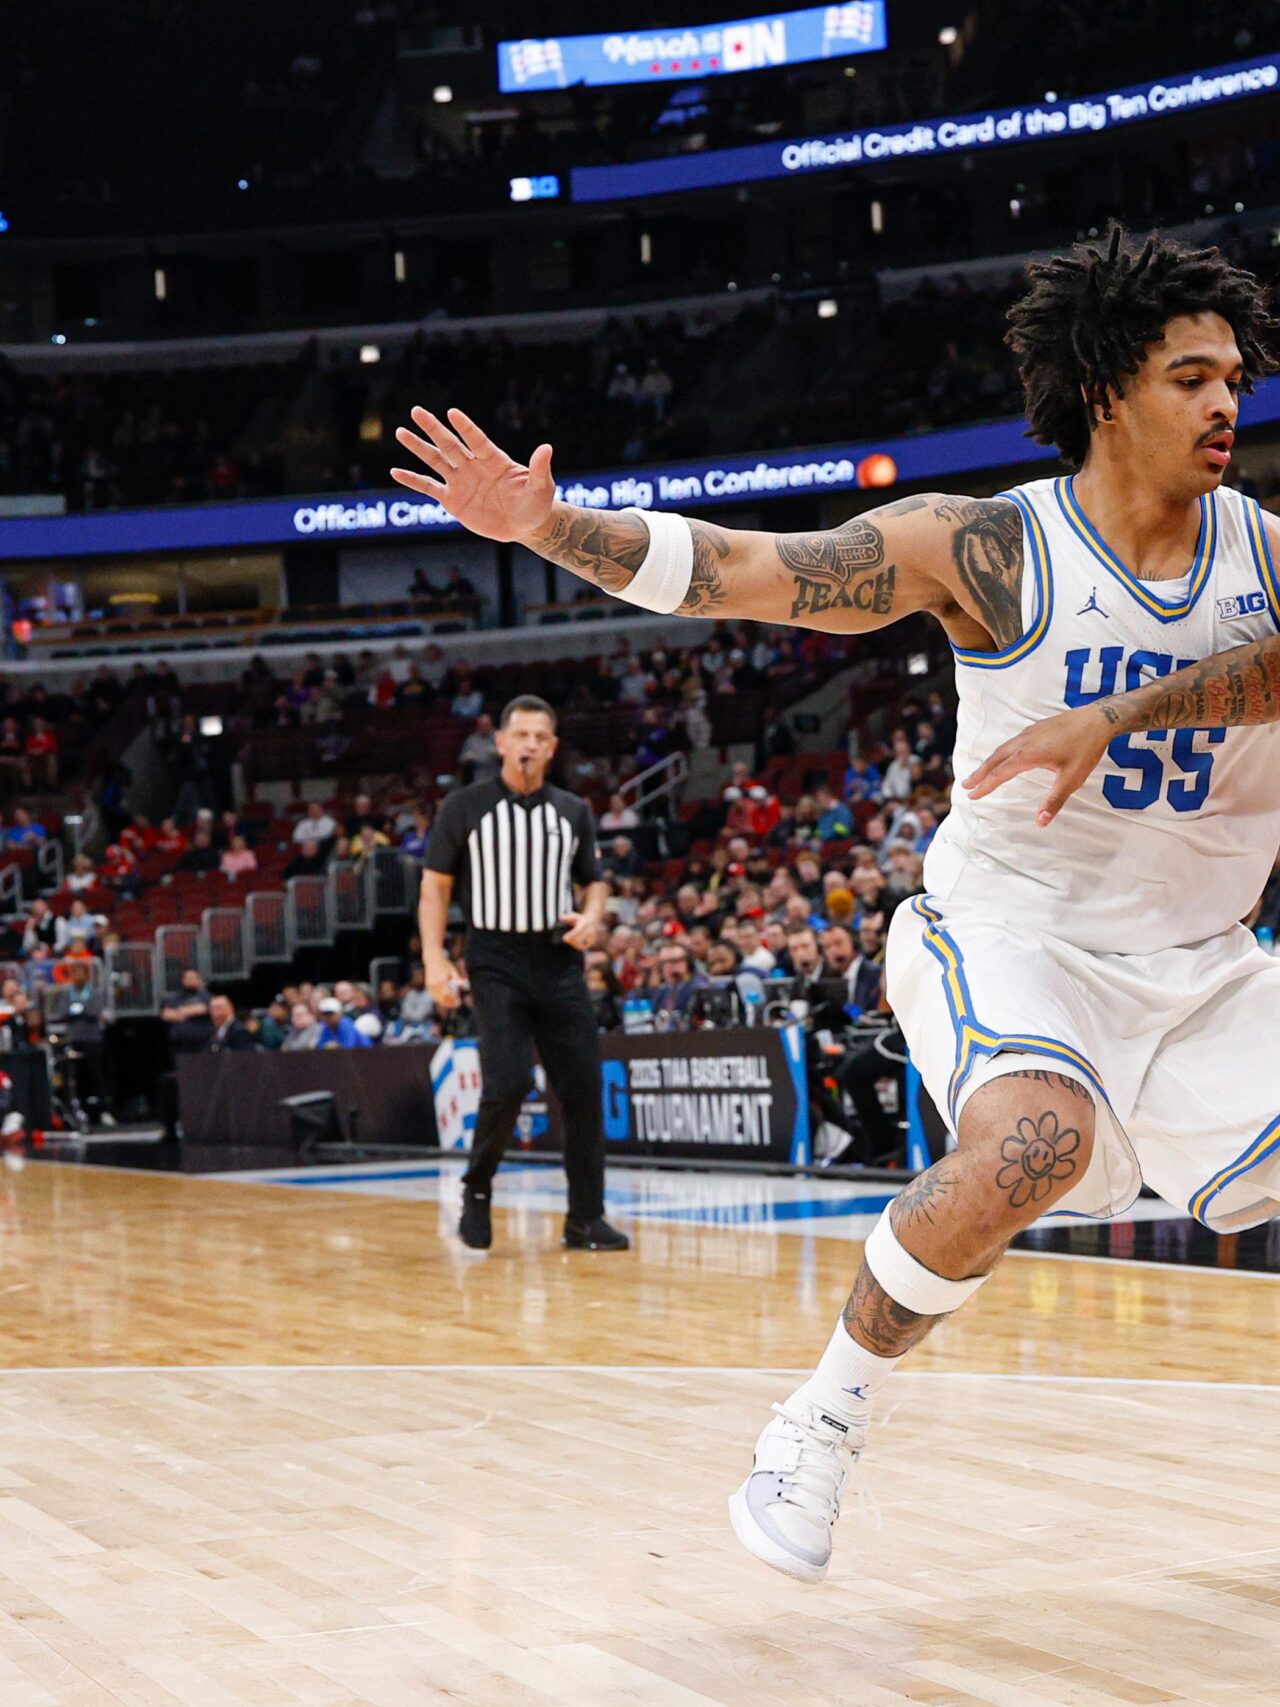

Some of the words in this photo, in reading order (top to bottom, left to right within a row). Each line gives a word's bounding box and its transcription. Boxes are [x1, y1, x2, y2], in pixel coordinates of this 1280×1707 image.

[781, 138, 862, 170] Official
[863, 126, 936, 158] Credit
[938, 116, 995, 148] Card
[996, 110, 1022, 138] of
[1025, 106, 1067, 135] the
[1068, 101, 1106, 131] Big
[1107, 94, 1147, 121] Ten
[1148, 64, 1278, 111] Conference
[565, 483, 609, 508] the
[703, 459, 854, 496] Conference
[294, 501, 386, 533] Official
[389, 501, 459, 526] Cred
[1063, 646, 1199, 709] UC
[1102, 727, 1227, 812] 55
[690, 1055, 772, 1088] BASKETBALL
[631, 1093, 773, 1145] TOURNAMENT
